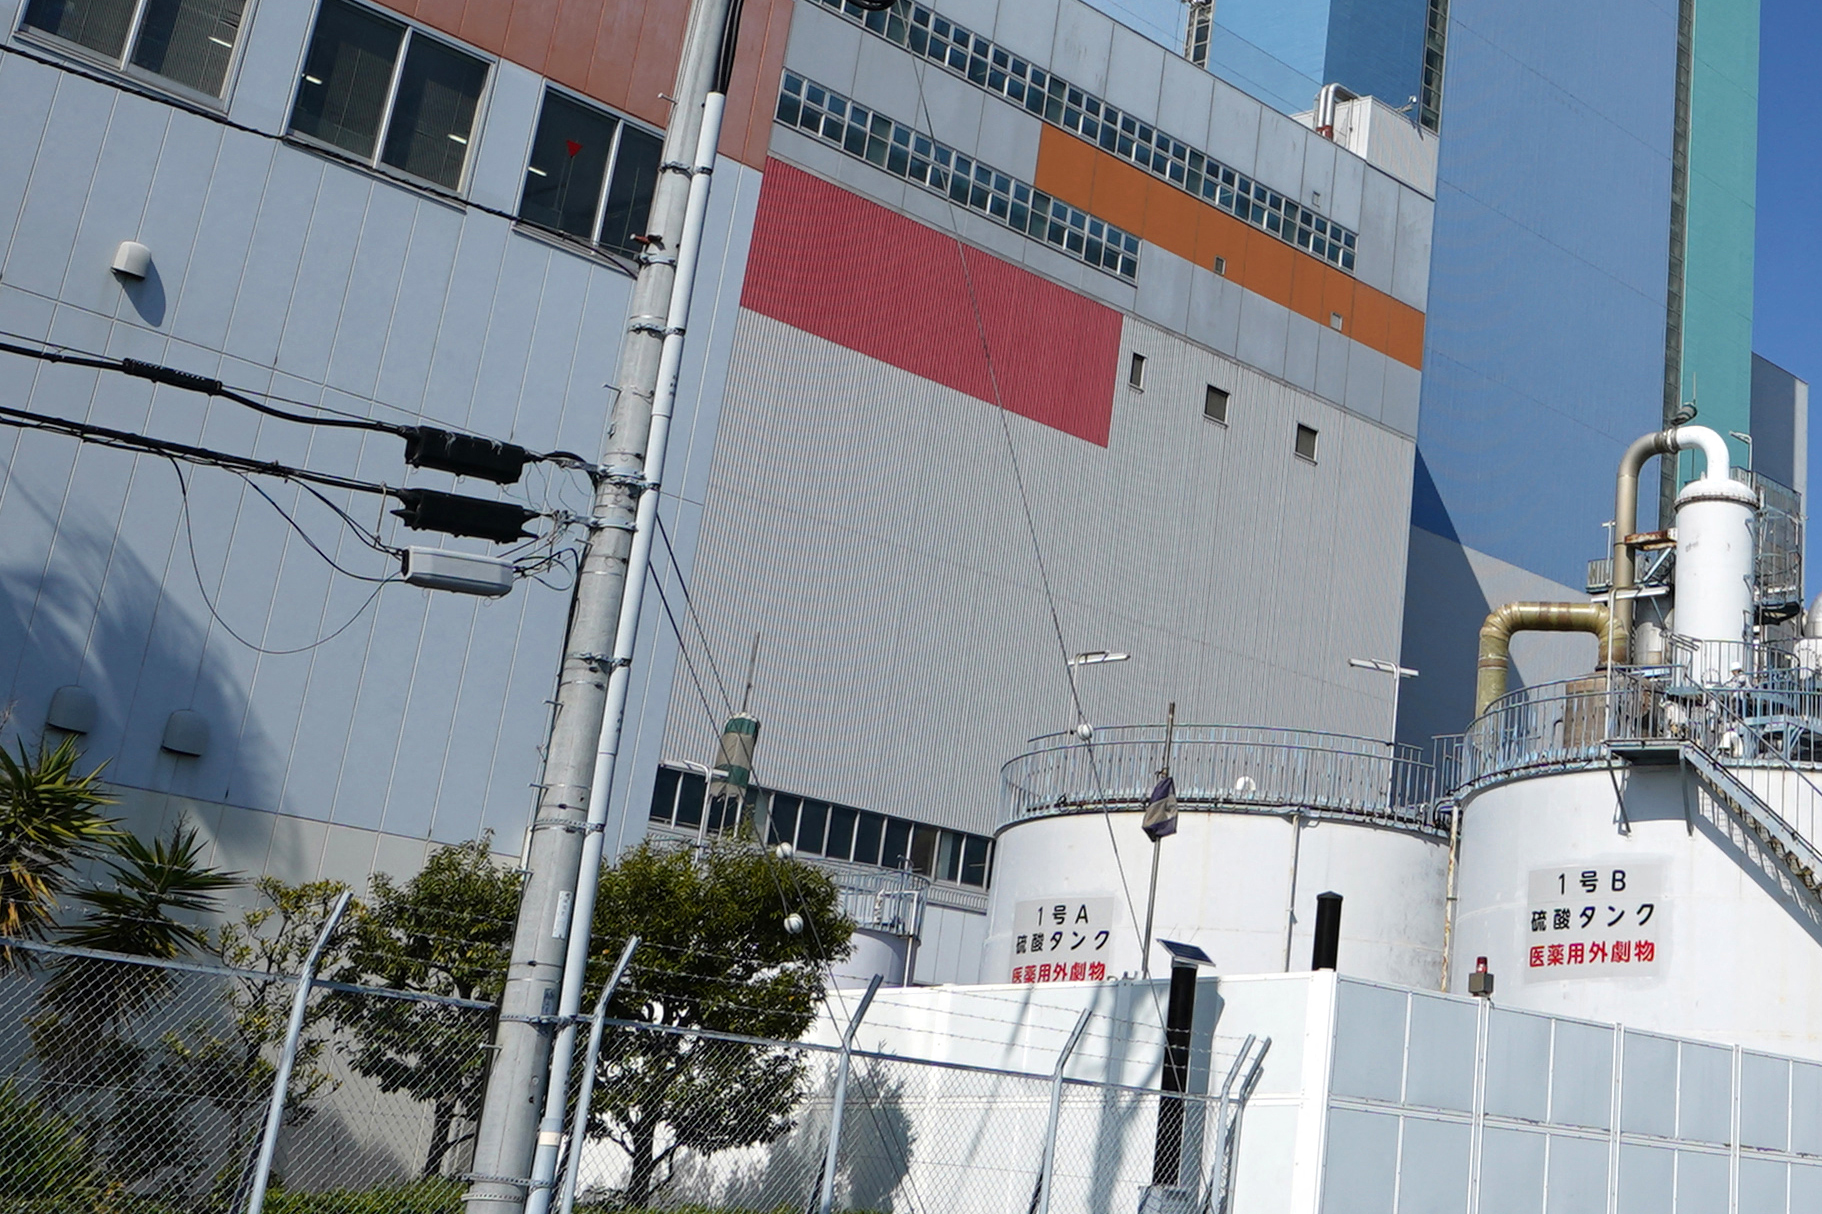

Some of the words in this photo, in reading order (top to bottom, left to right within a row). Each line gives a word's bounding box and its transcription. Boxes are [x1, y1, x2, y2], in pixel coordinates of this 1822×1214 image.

[1558, 869, 1627, 896] 1号B
[1037, 903, 1089, 927] 1号A
[1530, 903, 1655, 932] 硫酸タンク
[1015, 930, 1110, 955] 硫酸タンク
[1529, 939, 1656, 968] 医薬用外劇物
[1011, 960, 1106, 984] 医薬用外劇物
